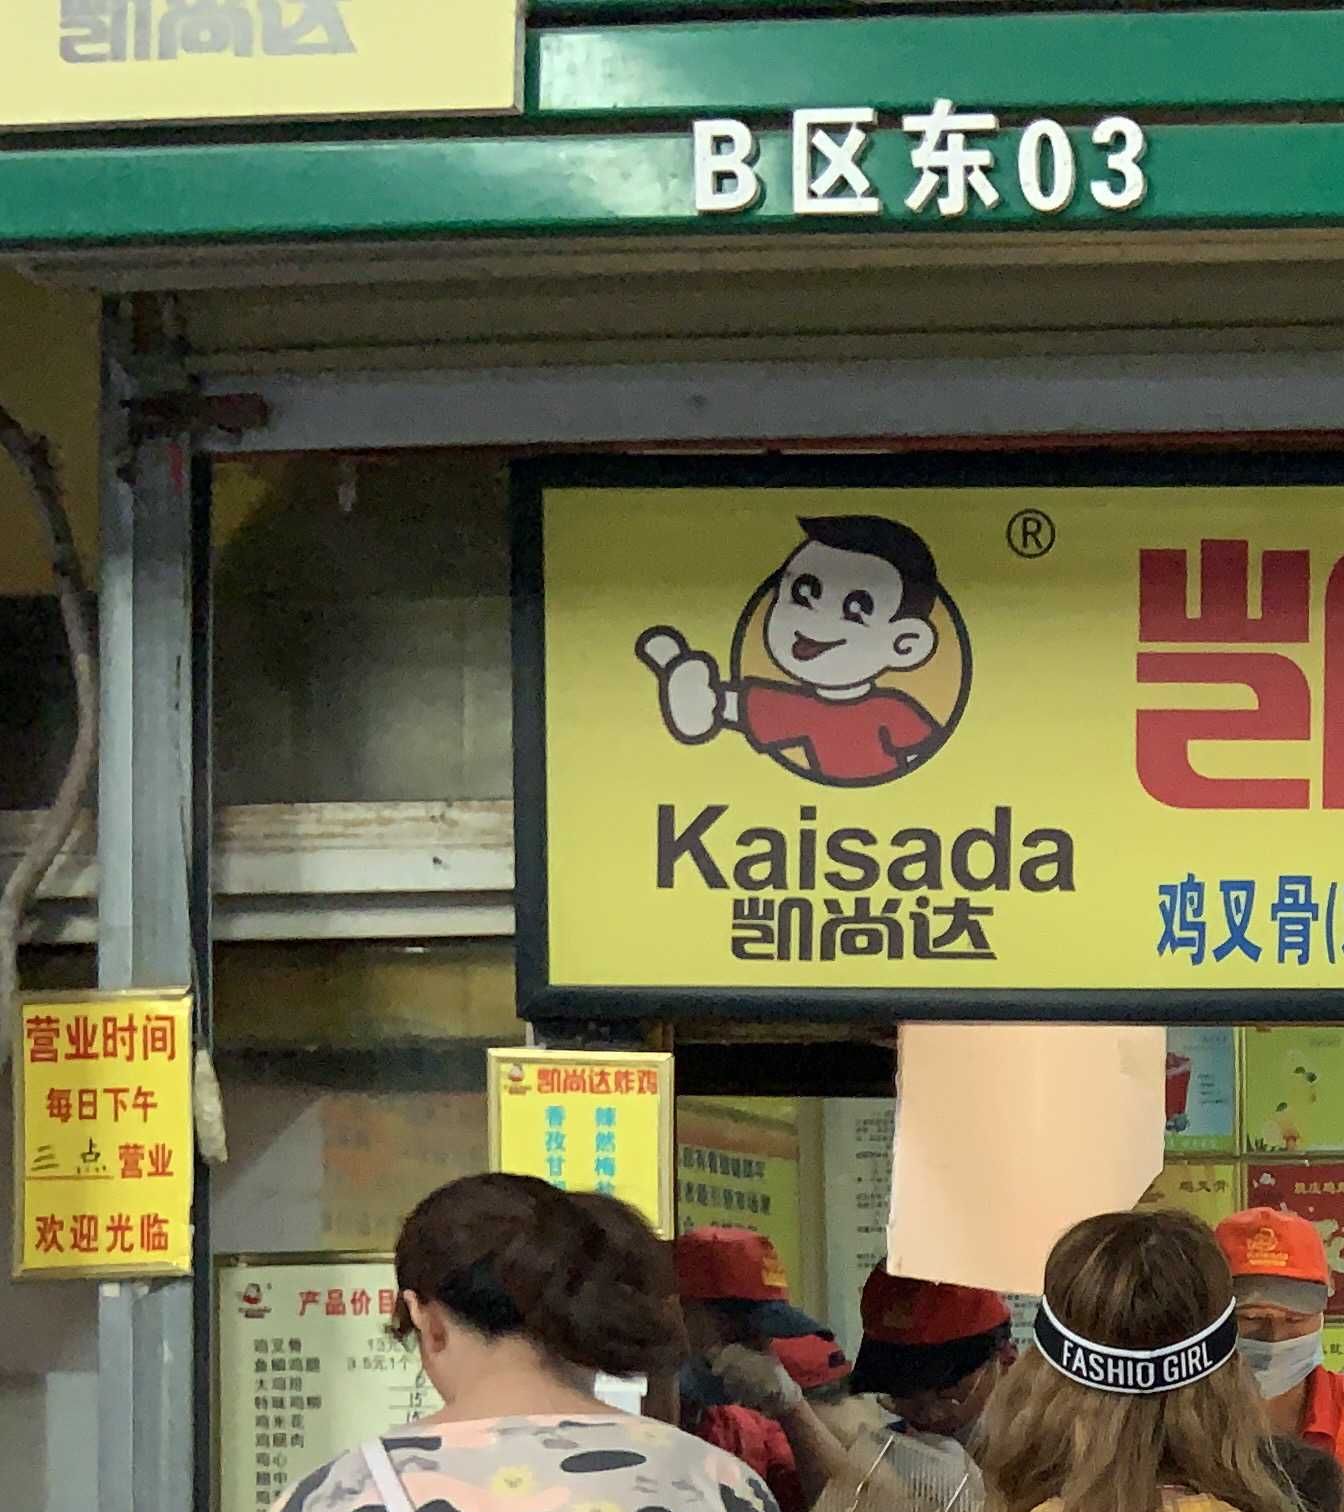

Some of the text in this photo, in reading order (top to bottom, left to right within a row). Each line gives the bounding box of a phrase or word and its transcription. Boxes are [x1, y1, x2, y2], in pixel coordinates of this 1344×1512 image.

[692, 98, 1148, 217] B区东03
[656, 804, 1076, 893] Kaisada
[731, 896, 998, 962] 凯尚达
[26, 1015, 178, 1063] 营业时间
[46, 1086, 158, 1123] 每日下午
[537, 1068, 659, 1094] 凯尚达炸鸡
[118, 1143, 174, 1179] 营业
[34, 1213, 170, 1255] 欢迎光临
[1061, 1339, 1214, 1388] FASHIO GIRL
